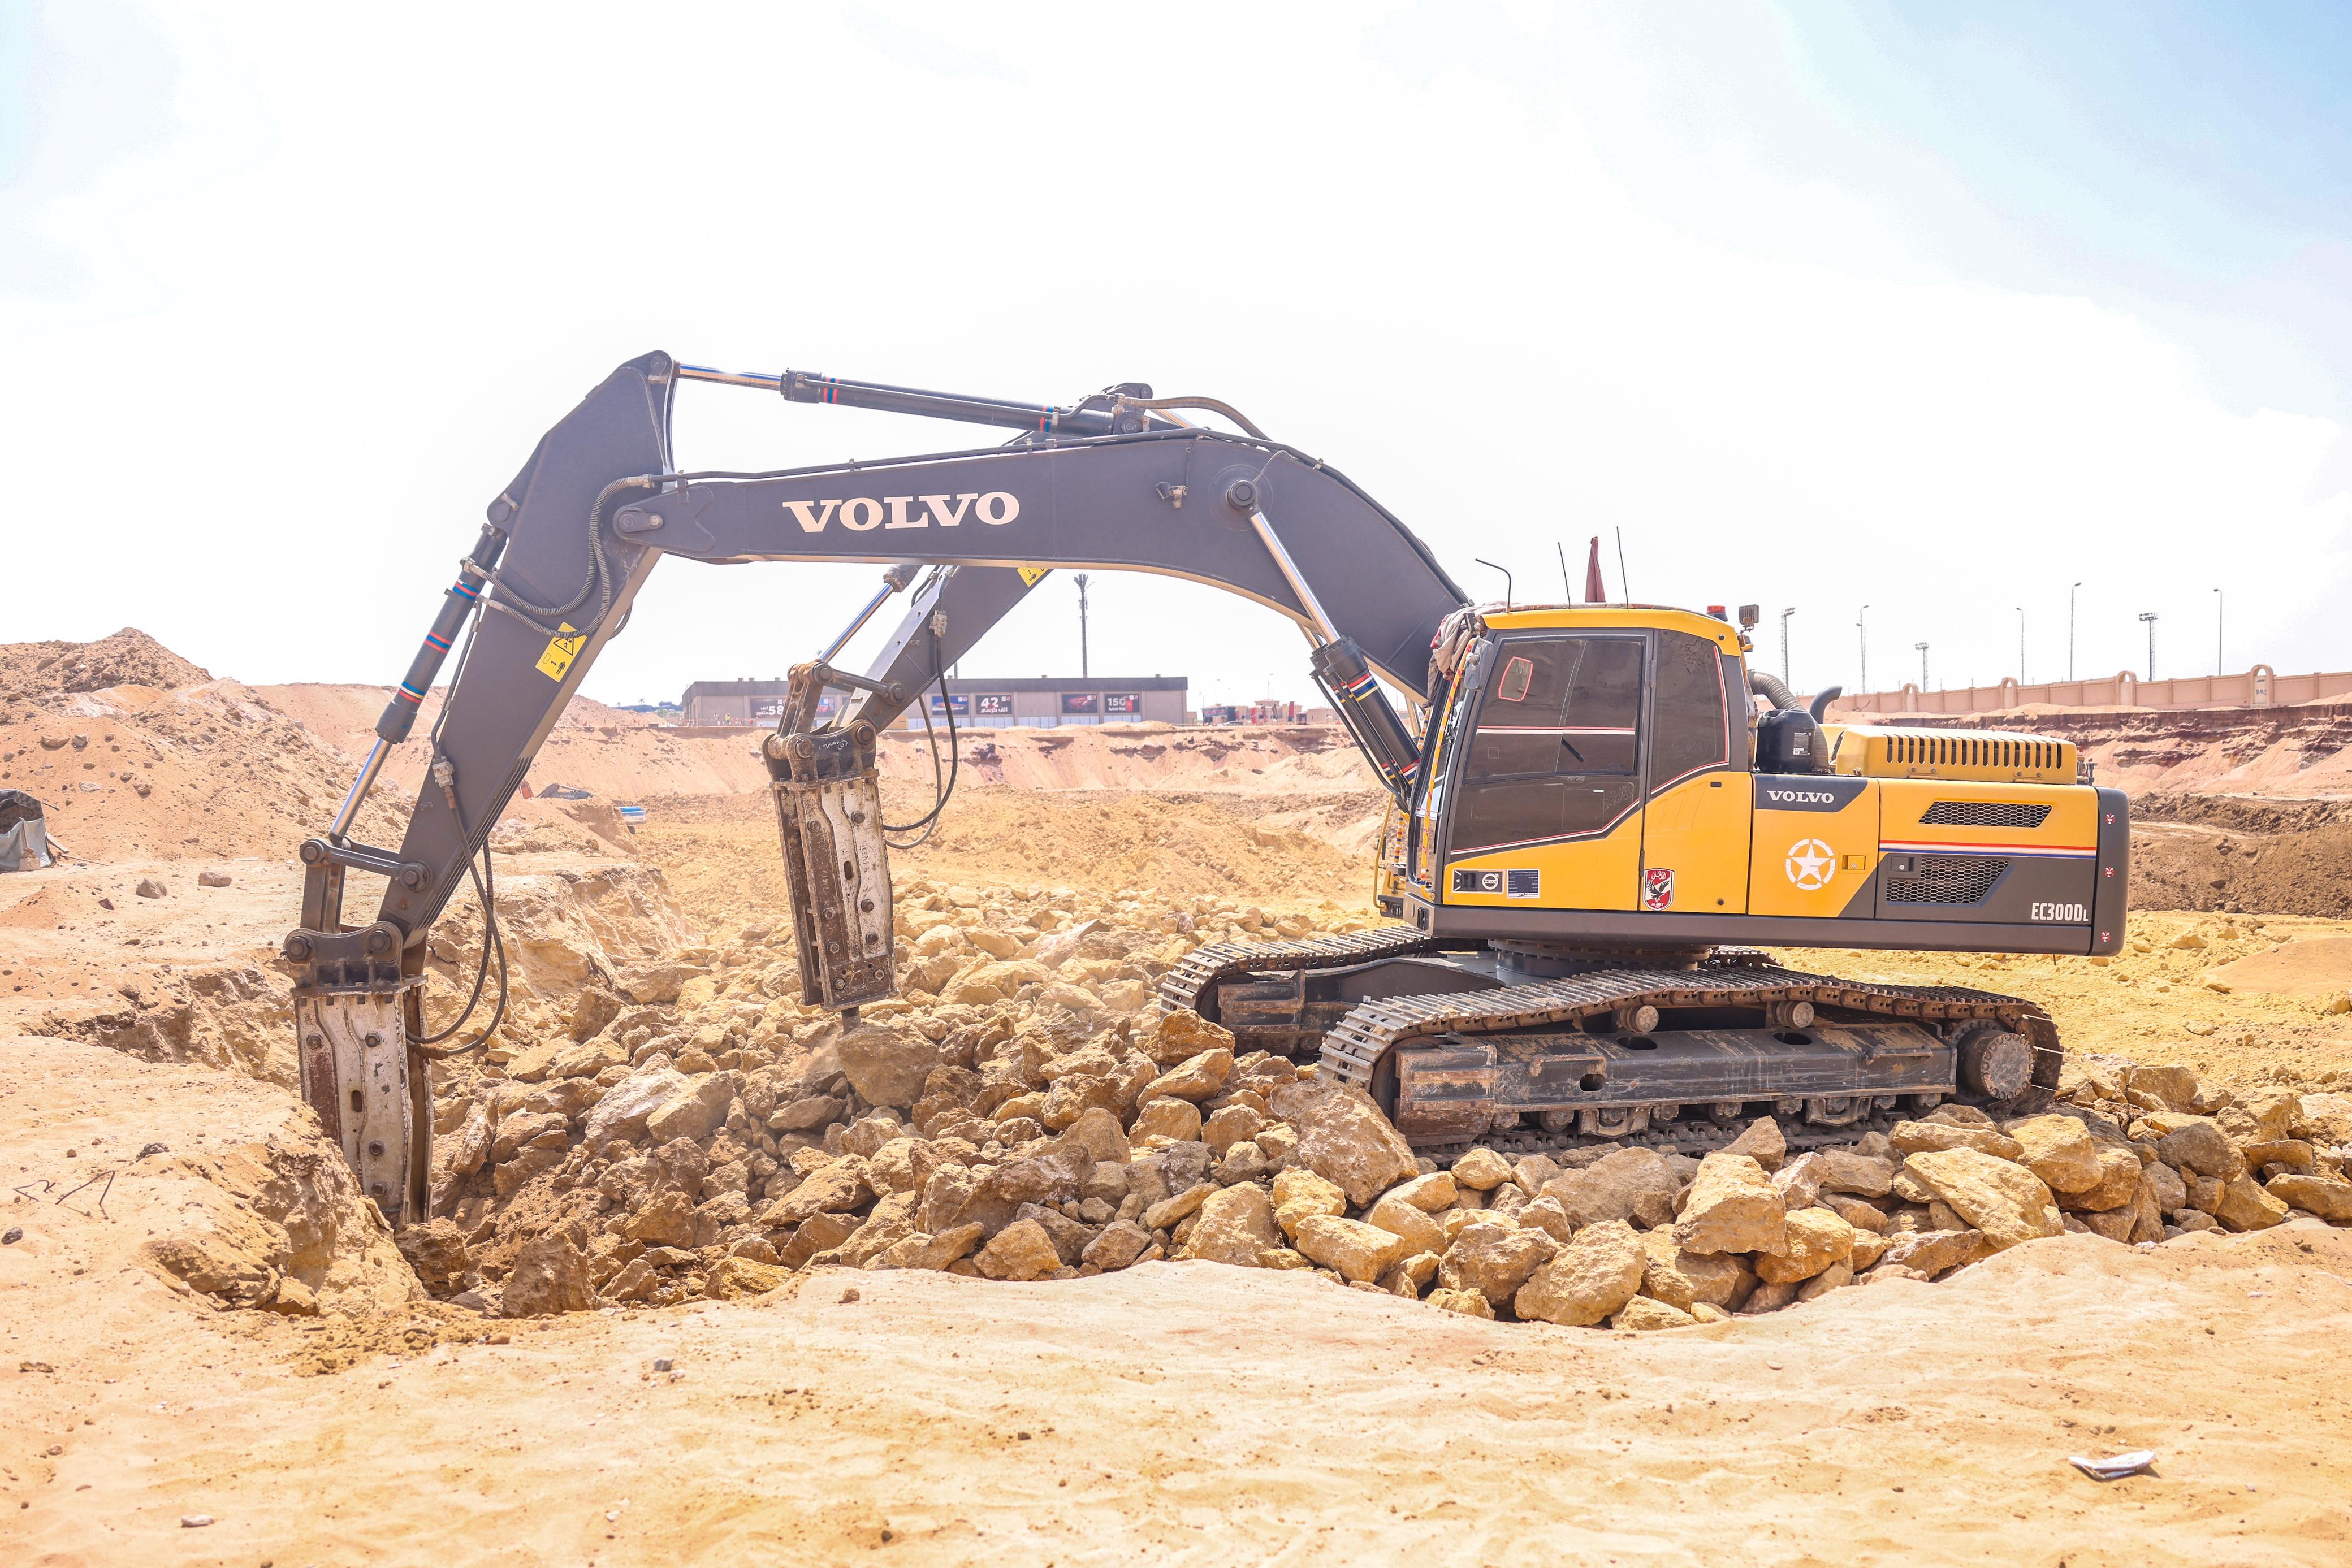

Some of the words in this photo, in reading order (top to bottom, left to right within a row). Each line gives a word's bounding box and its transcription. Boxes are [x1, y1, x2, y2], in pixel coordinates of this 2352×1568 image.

[782, 492, 1019, 532] VOLVO
[981, 697, 998, 708] 42
[769, 705, 784, 715] 58
[1766, 790, 1834, 803] VOLVO
[2031, 902, 2089, 921] EC300DL
